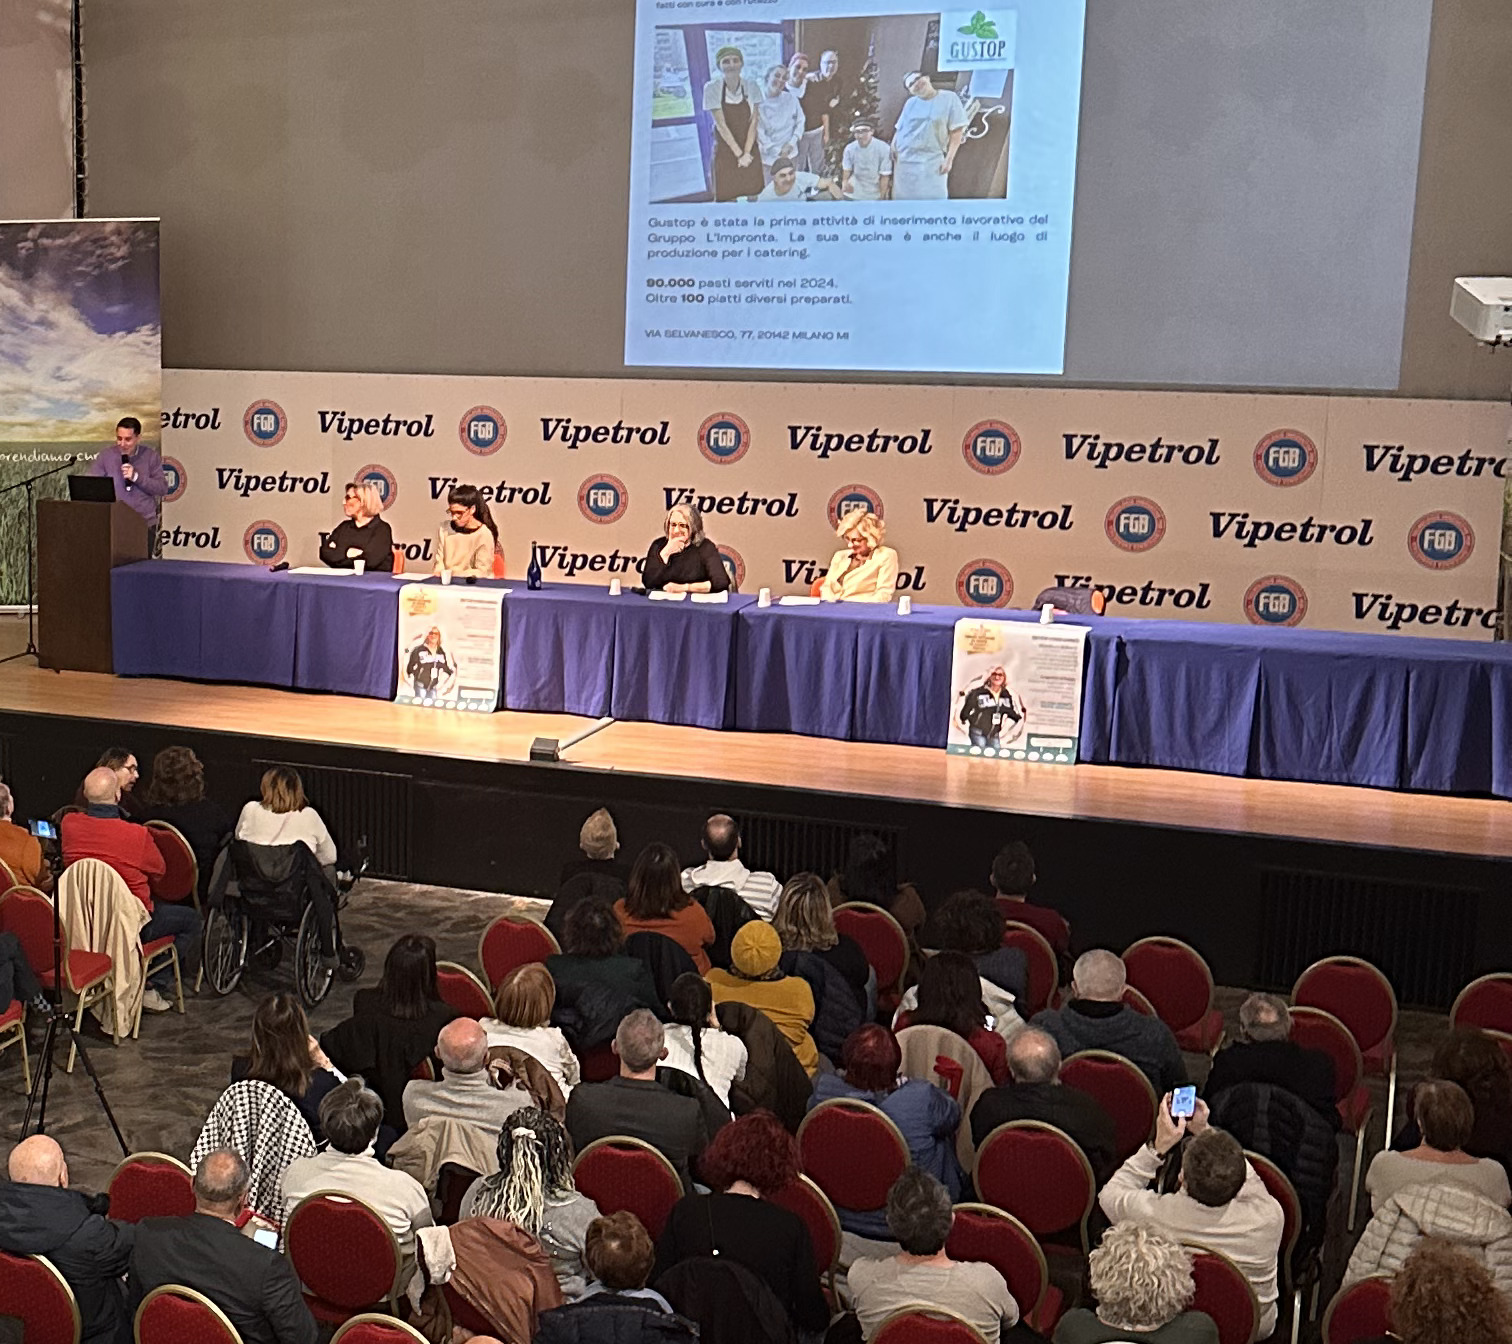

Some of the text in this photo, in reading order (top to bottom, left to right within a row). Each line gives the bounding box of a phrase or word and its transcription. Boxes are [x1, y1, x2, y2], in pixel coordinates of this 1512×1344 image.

[950, 40, 1006, 59] GUSTOP
[648, 214, 1048, 230] Gustop è stata la prima attività di inserimento lavorativo del
[648, 230, 1048, 245] Gruppo L'Impronta. La sua cucina è anche il luogo di
[648, 248, 718, 260] produzione
[722, 249, 743, 260] per
[754, 248, 810, 260] catering.
[698, 278, 731, 290] pasti
[734, 278, 774, 288] serviti
[777, 278, 796, 288] nel
[800, 278, 838, 288] 2024.
[646, 293, 852, 306] Oltre 100 piatti diversi preparati.
[644, 329, 850, 340] VIA SELVANESCO, 77, 20142 MILANO MI
[160, 406, 222, 430] etrol
[317, 410, 435, 441] Vipetrol
[470, 421, 494, 440] FGB
[540, 417, 671, 449] Vipetrol
[708, 428, 738, 449] FGB
[787, 425, 933, 458] Vipetrol
[976, 436, 1005, 458] FGB
[1062, 433, 1221, 469] Vipetrol
[1268, 446, 1300, 469] FGB
[1362, 444, 1508, 482] Vipetro
[76, 452, 101, 461] cur
[216, 467, 330, 498] Vipetrol
[589, 489, 615, 508] FGB
[923, 498, 1074, 532] Vipetrol
[1118, 512, 1149, 535] FGB
[1209, 512, 1374, 548] Vipetrol
[1422, 529, 1457, 552] FGB
[160, 525, 222, 549] etrol
[1258, 592, 1290, 615] FGB
[1351, 592, 1501, 631] Vipetro
